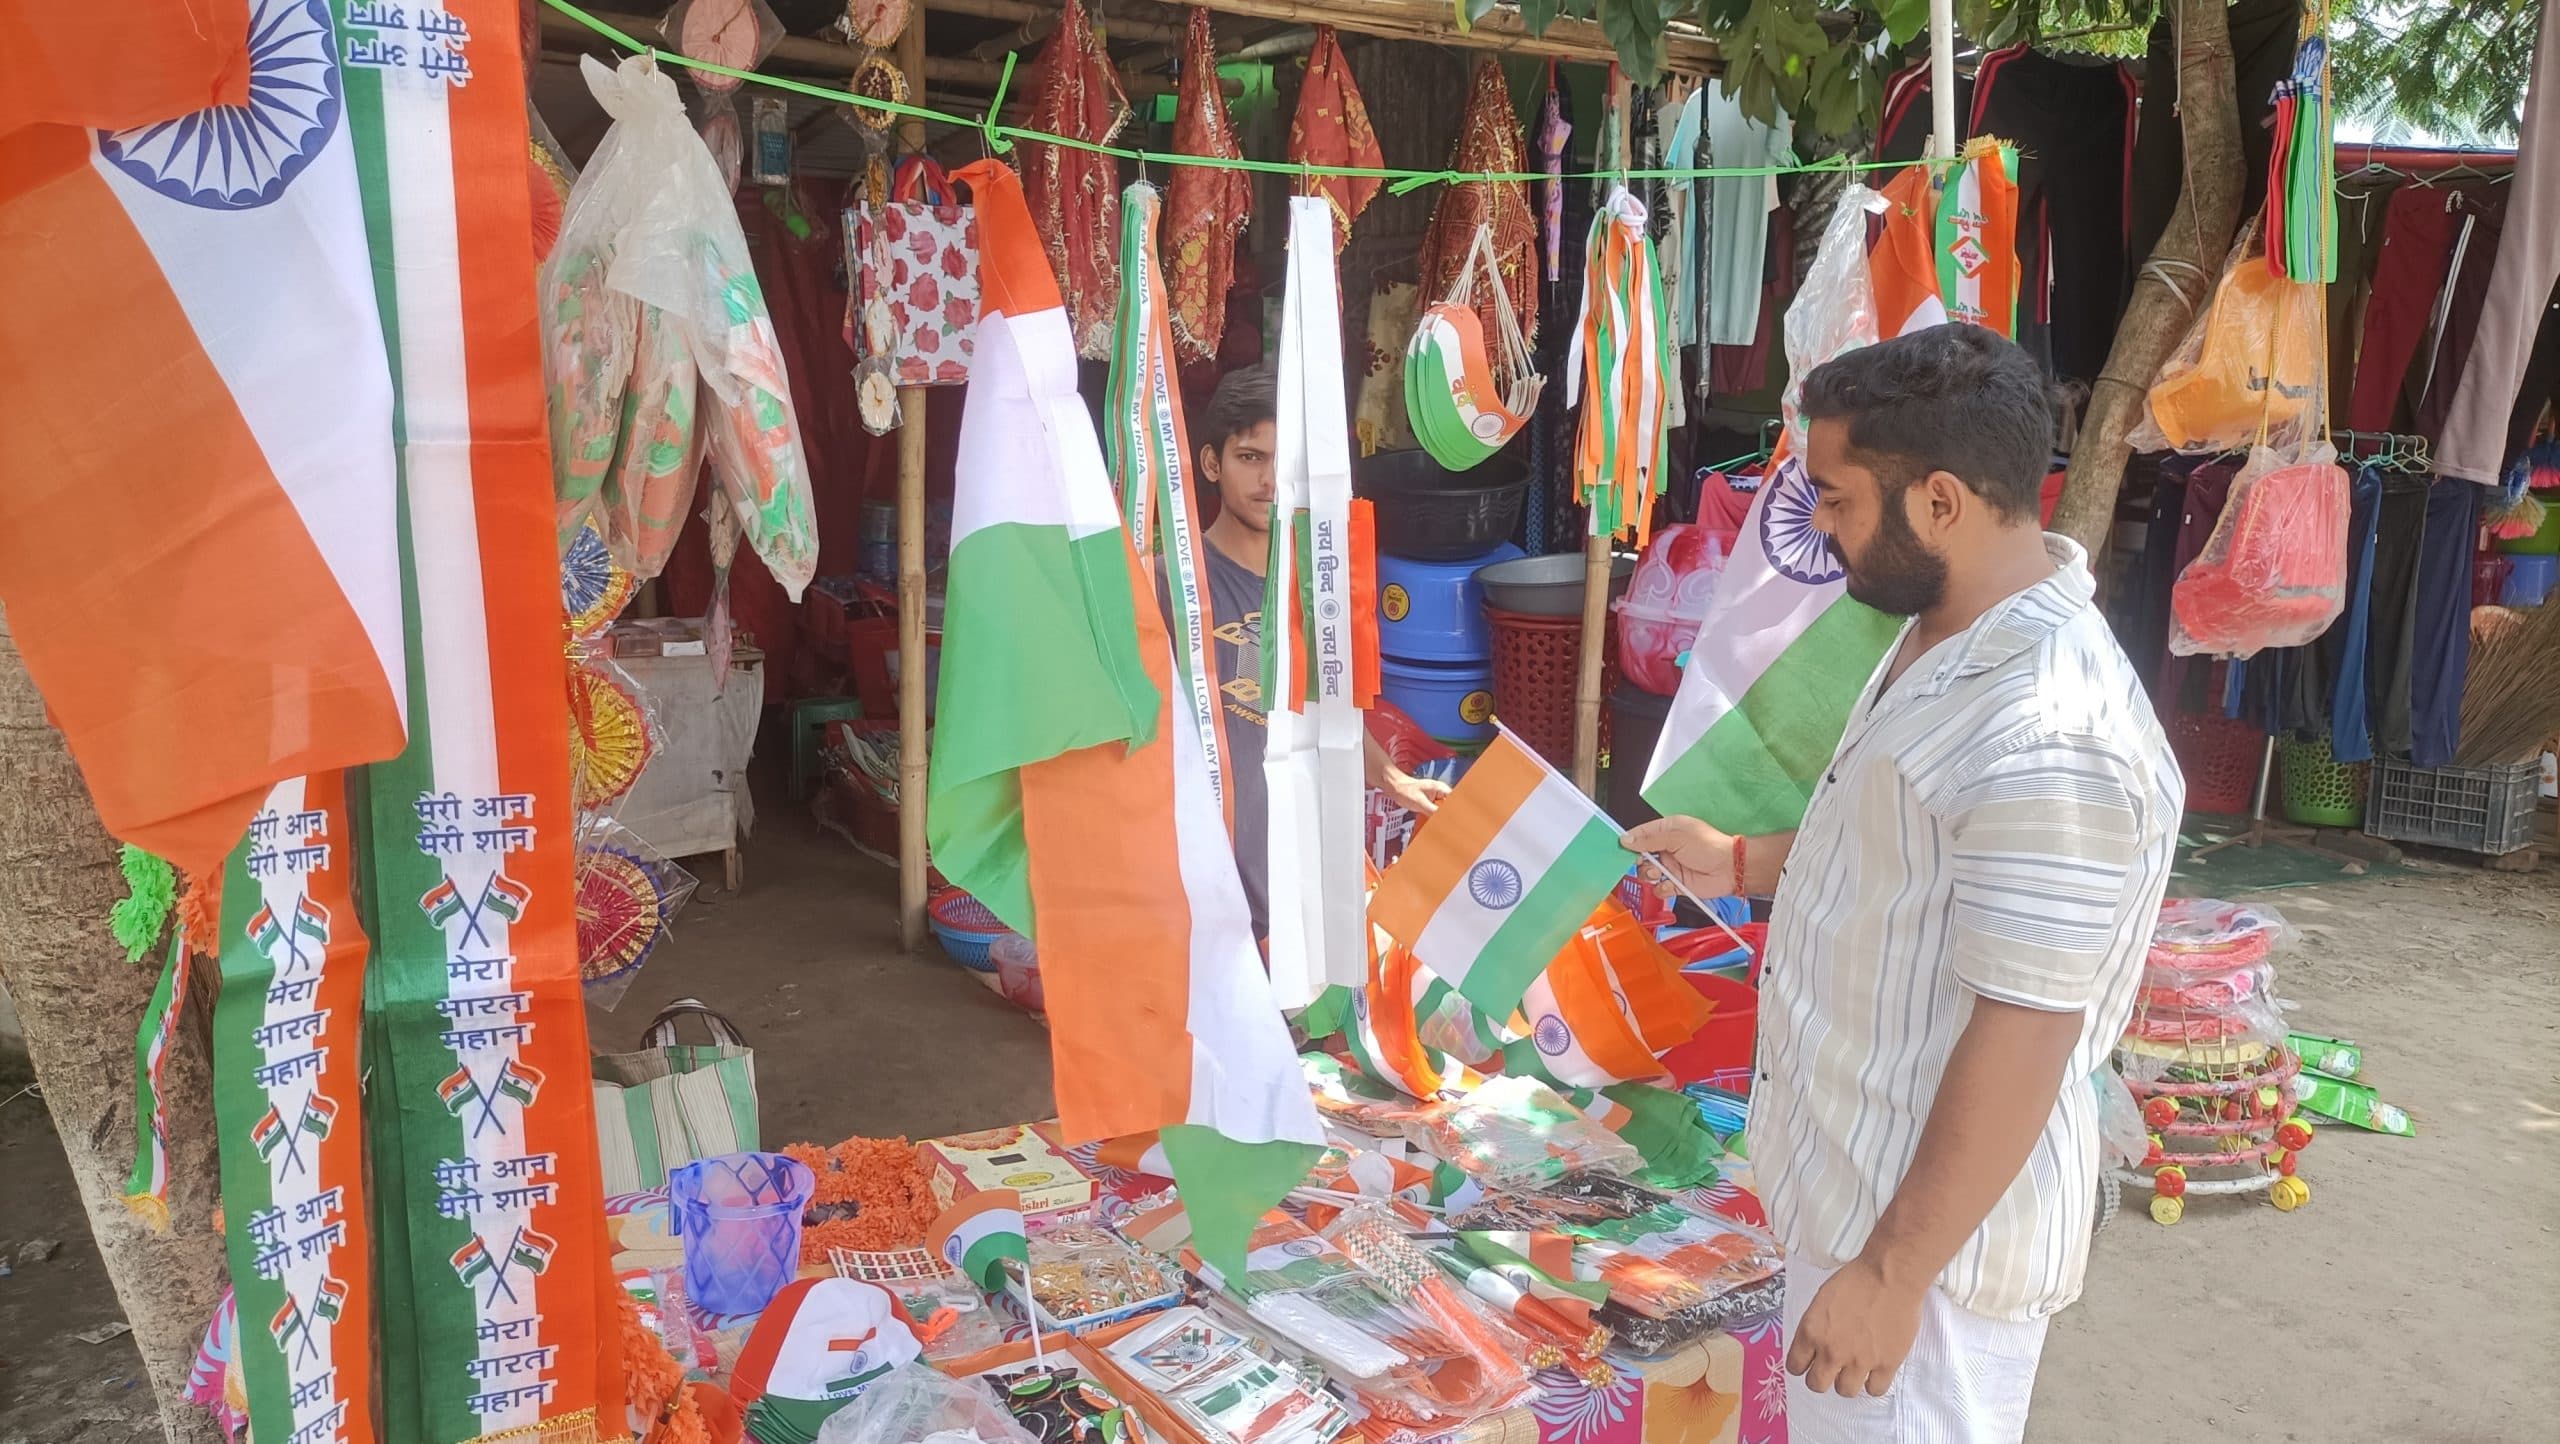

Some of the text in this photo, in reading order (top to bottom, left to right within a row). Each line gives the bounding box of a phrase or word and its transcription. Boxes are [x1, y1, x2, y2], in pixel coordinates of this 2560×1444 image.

[1139, 258, 1149, 305] INDIA
[1137, 342, 1146, 383] LOVE
[1153, 364, 1167, 404] LOVE
[1132, 402, 1142, 425] MY
[1161, 422, 1174, 444] MY
[1134, 430, 1147, 475] INDIA
[1166, 448, 1181, 493] INDIA
[1176, 528, 1191, 566] LOVE
[1185, 585, 1197, 605] MY
[1318, 519, 1343, 698] जय हिन्द जय हिन्द
[1189, 610, 1202, 653] INDIA
[1196, 687, 1212, 726] LOVE
[1206, 743, 1219, 766] MY
[413, 791, 528, 820] मेरी आन
[285, 811, 322, 835] आन
[415, 824, 529, 854] मेरी शान
[246, 844, 326, 877] मेरी शान
[446, 954, 509, 982] मेरा
[266, 977, 319, 1006] मेरा
[434, 993, 526, 1017] भारत
[252, 1011, 326, 1048] भारत
[438, 1024, 528, 1051] महान
[253, 1049, 323, 1087] महान
[431, 1155, 549, 1185] मेरी आन
[246, 1189, 338, 1242] मेरी आन
[433, 1185, 550, 1216] मेरी शान
[252, 1224, 341, 1278] मेरी शान
[474, 1317, 535, 1343] मेरा
[463, 1348, 551, 1379] भारत
[288, 1371, 332, 1409] मेरा
[464, 1382, 550, 1414] महान
